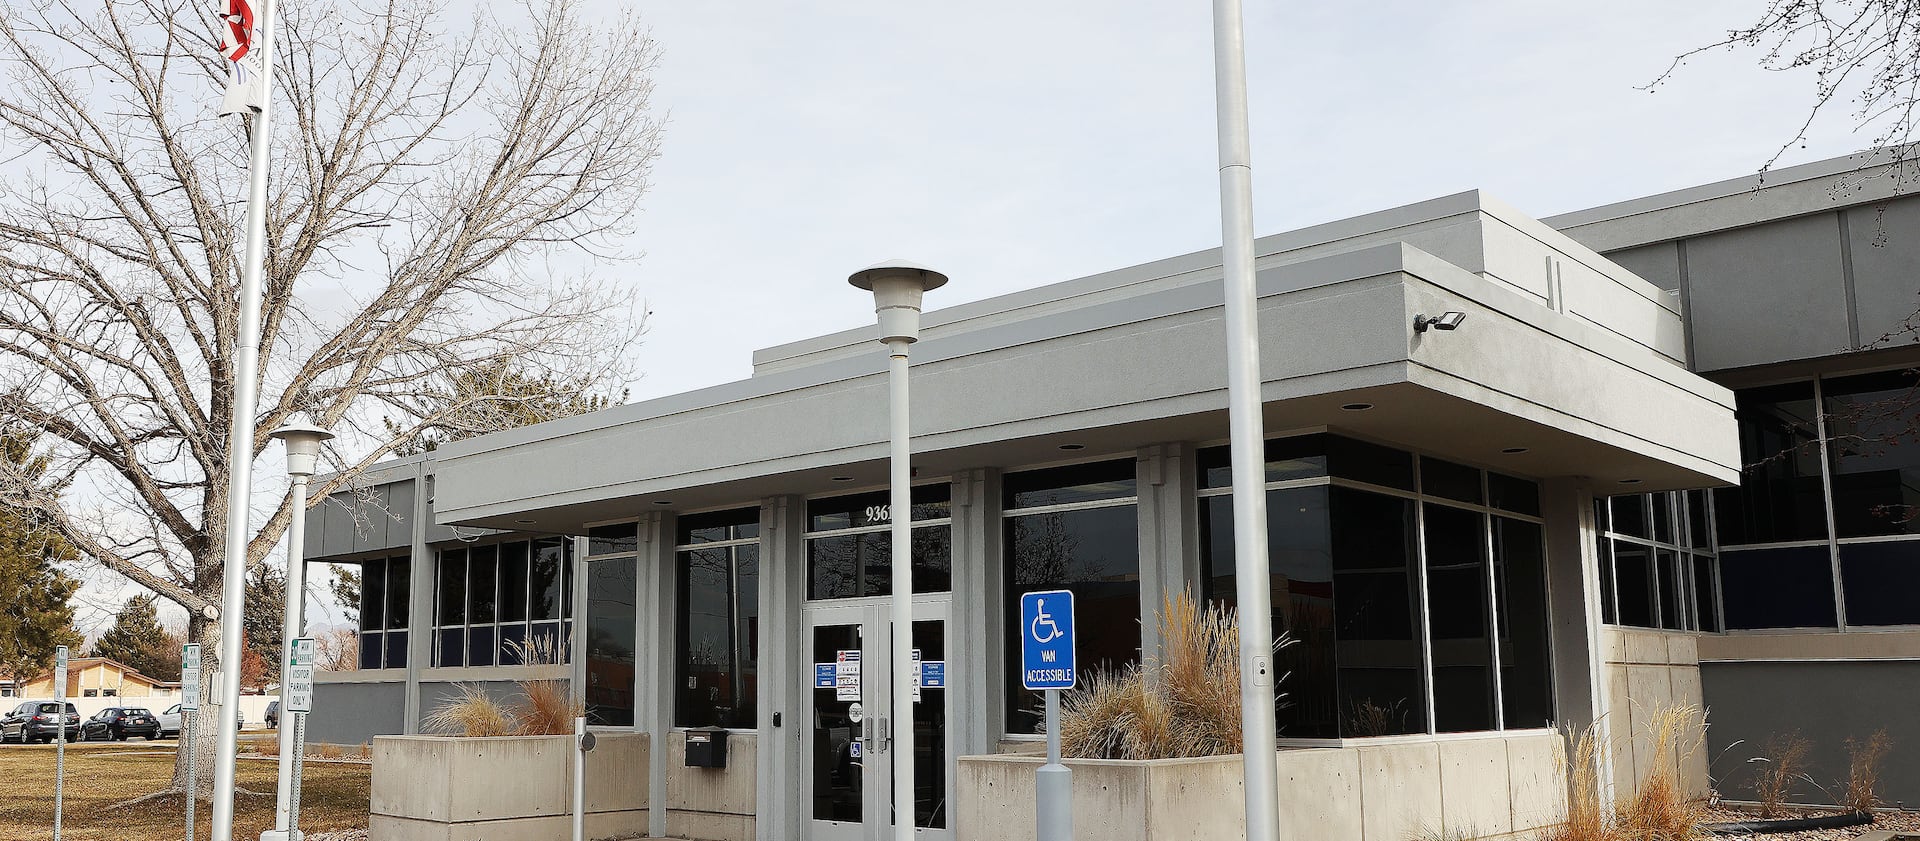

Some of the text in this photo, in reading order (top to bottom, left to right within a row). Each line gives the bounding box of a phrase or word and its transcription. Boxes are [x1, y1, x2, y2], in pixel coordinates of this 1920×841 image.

[1041, 650, 1056, 662] VAN
[292, 669, 310, 679] VISITOR
[1027, 669, 1072, 682] ACCESSIBLE
[290, 682, 310, 692] PARKING
[292, 695, 306, 706] ONLY
